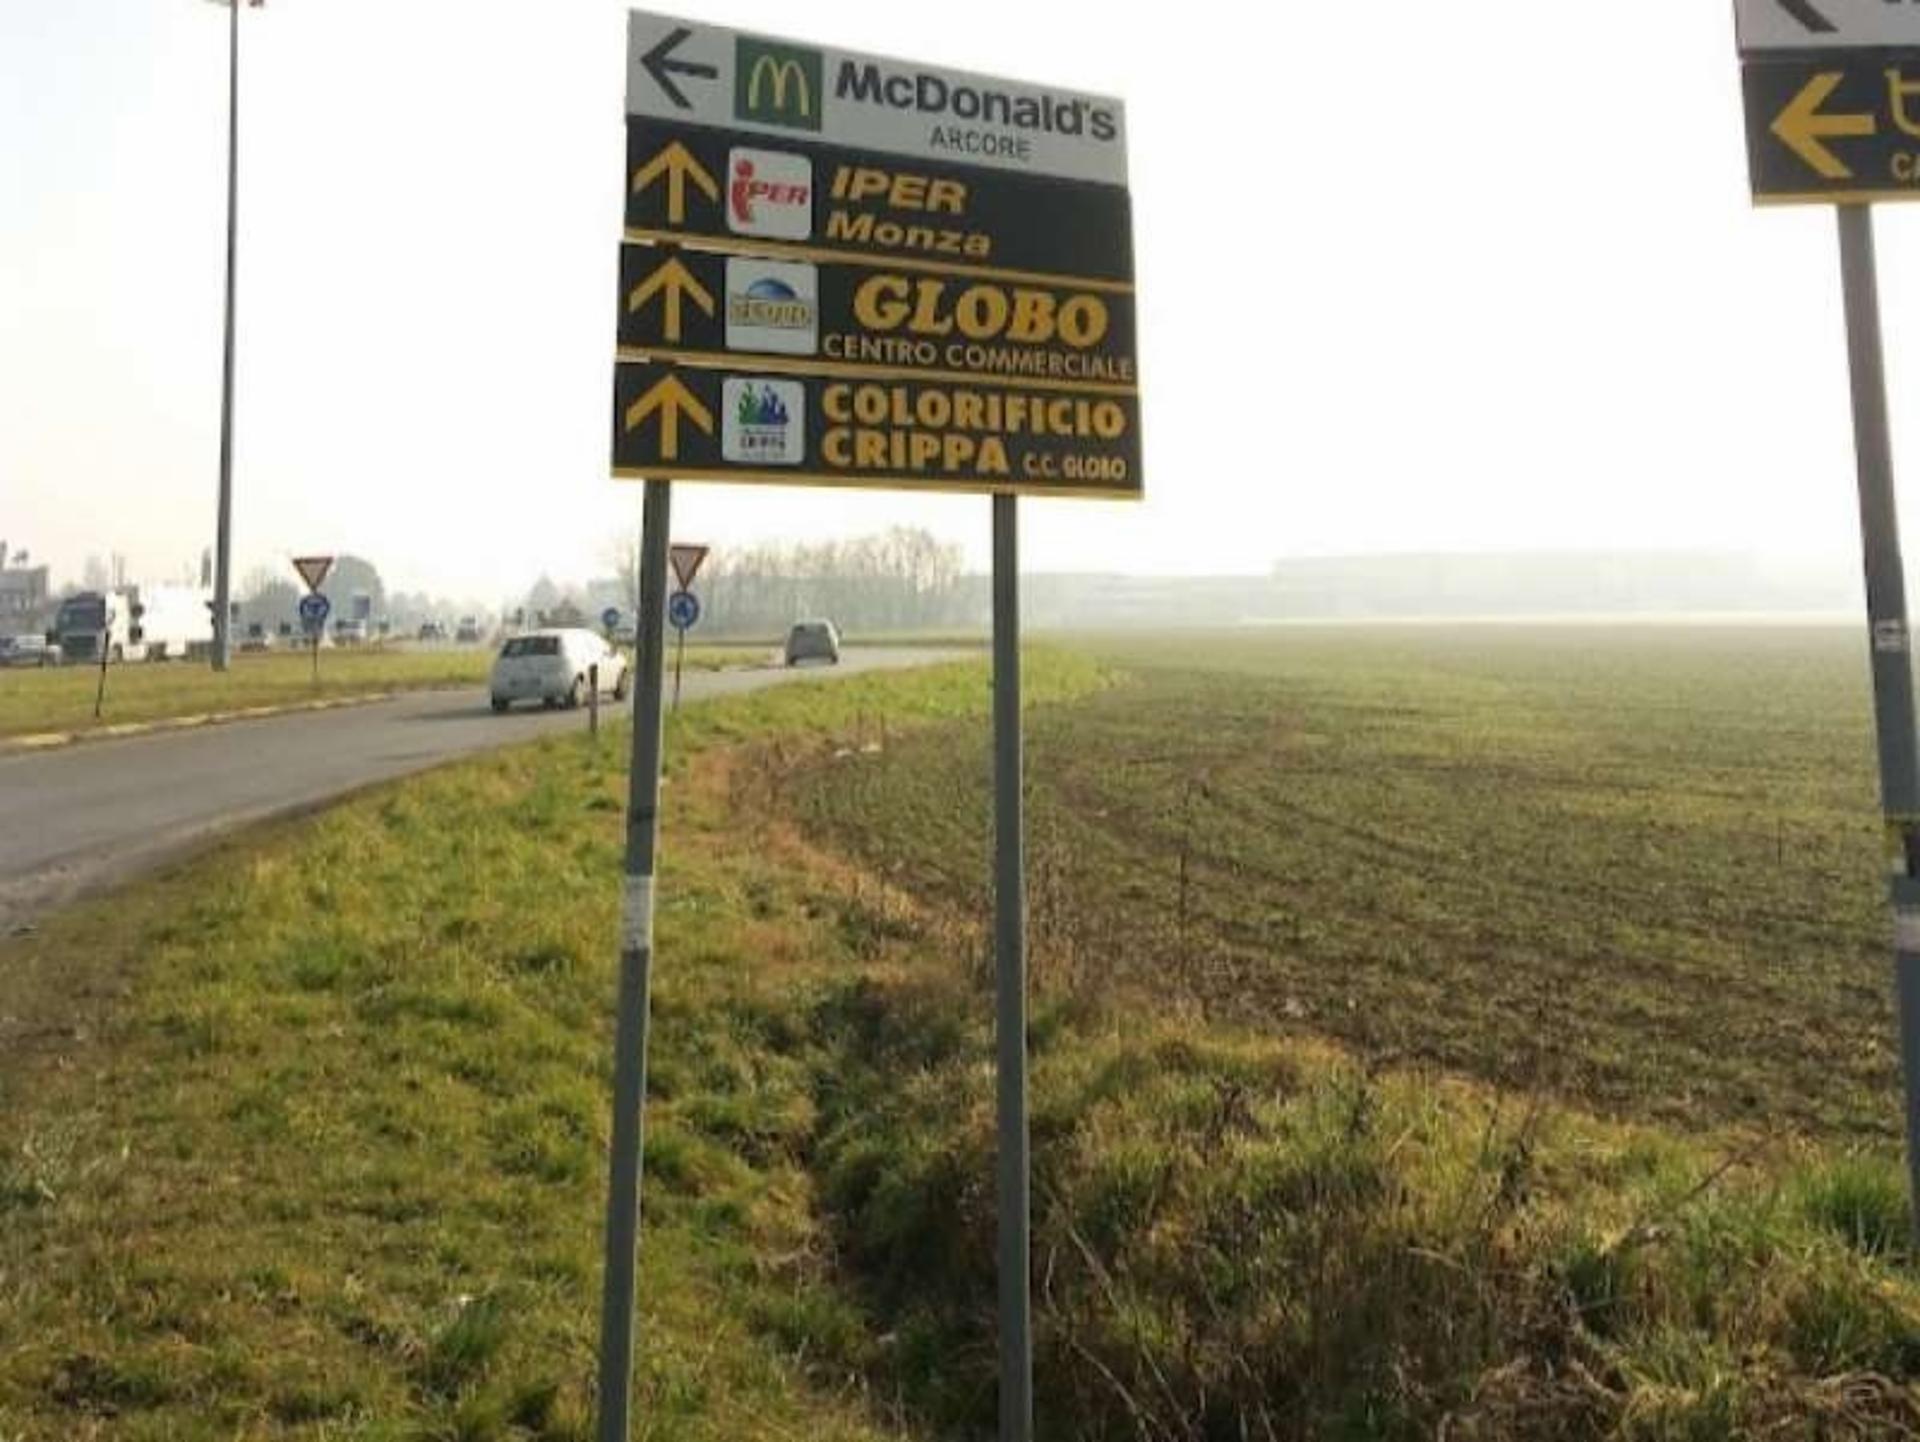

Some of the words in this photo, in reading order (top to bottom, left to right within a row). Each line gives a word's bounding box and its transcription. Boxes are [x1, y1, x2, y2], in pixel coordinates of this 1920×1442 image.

[836, 60, 1116, 141] McDonald's
[930, 126, 1032, 160] ARCORE
[832, 166, 968, 214] IPER
[828, 210, 990, 257] Monza
[853, 275, 1108, 347] GLOBO
[823, 335, 937, 365] CENTRO
[946, 345, 1133, 380] COMMERCIALE
[822, 383, 1126, 438] COLORIFICIO
[821, 430, 1009, 475] CRIPPA
[1063, 455, 1127, 479] GLOBO
